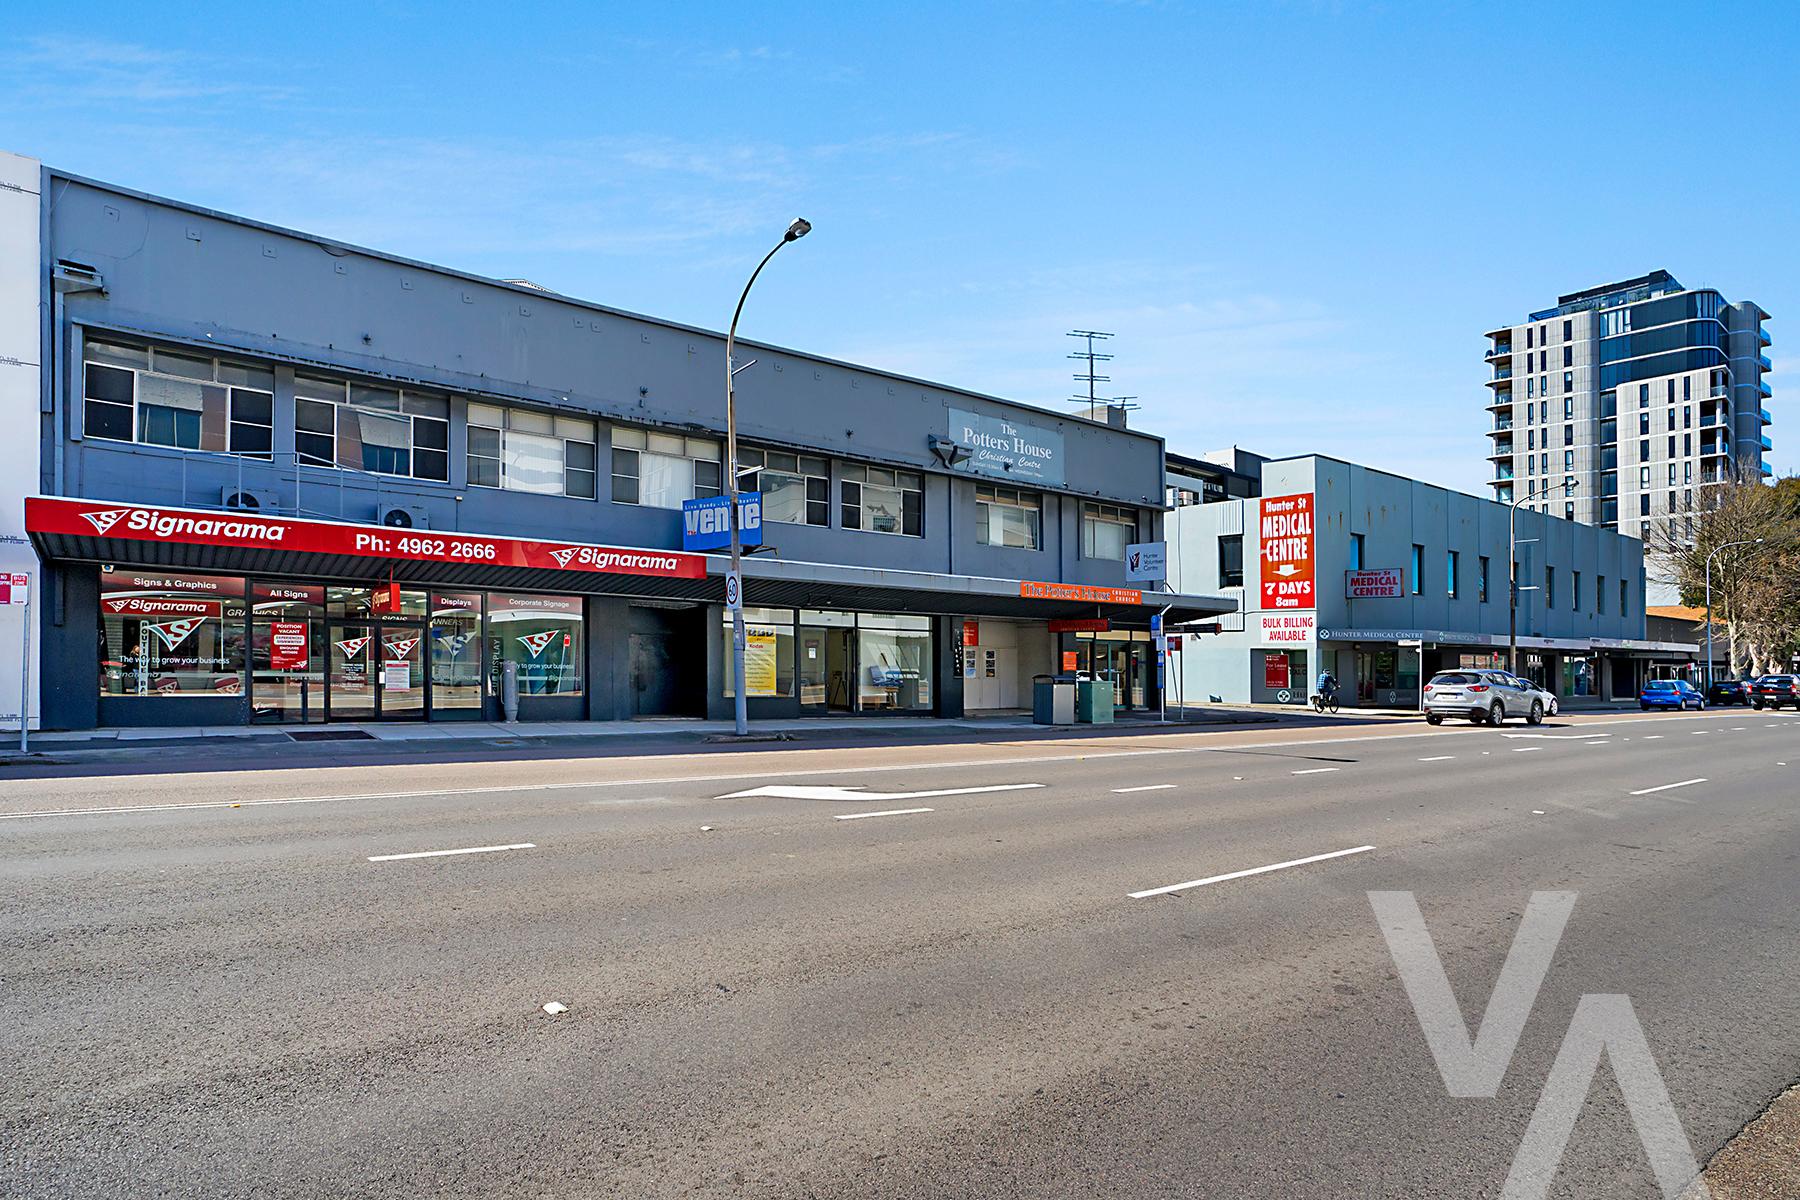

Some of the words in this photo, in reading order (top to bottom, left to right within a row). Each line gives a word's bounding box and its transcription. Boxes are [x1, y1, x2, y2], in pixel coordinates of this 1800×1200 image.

[1001, 423, 1017, 436] The
[963, 427, 1009, 451] Potters
[1014, 438, 1052, 459] House
[979, 449, 1014, 464] Christian
[1018, 457, 1041, 469] Centre
[1266, 501, 1295, 513] Hunter
[1298, 498, 1306, 509] St
[128, 510, 285, 541] Signarama
[1262, 512, 1311, 538] MEDICAL
[356, 534, 391, 552] Ph:
[398, 538, 445, 556] 4962
[450, 542, 496, 559] 2666
[1266, 537, 1308, 562] CENTRE
[579, 548, 677, 570] Signarama
[134, 578, 161, 588] Signs
[165, 579, 172, 587] &
[175, 580, 217, 590] Graphics
[1350, 576, 1398, 586] MEDICAL
[728, 584, 736, 596] 60
[1024, 583, 1043, 597] The
[1045, 585, 1079, 600] Potter's
[1081, 587, 1111, 601] House
[1265, 582, 1276, 595] 7
[1279, 581, 1311, 595] DAYS
[1353, 587, 1394, 596] CENTRE
[284, 590, 308, 599] Signs
[129, 600, 207, 612] Signarama
[441, 598, 472, 607] Displays
[509, 598, 541, 607] Corporate
[543, 600, 569, 608] Signage
[1275, 597, 1298, 607] 8am
[1262, 618, 1281, 629] BULK
[1284, 617, 1313, 628] BILLING
[1269, 630, 1306, 641] AVAILABLE
[120, 655, 133, 663] The
[162, 657, 180, 665] grow
[182, 657, 198, 665] your
[199, 656, 230, 664] business
